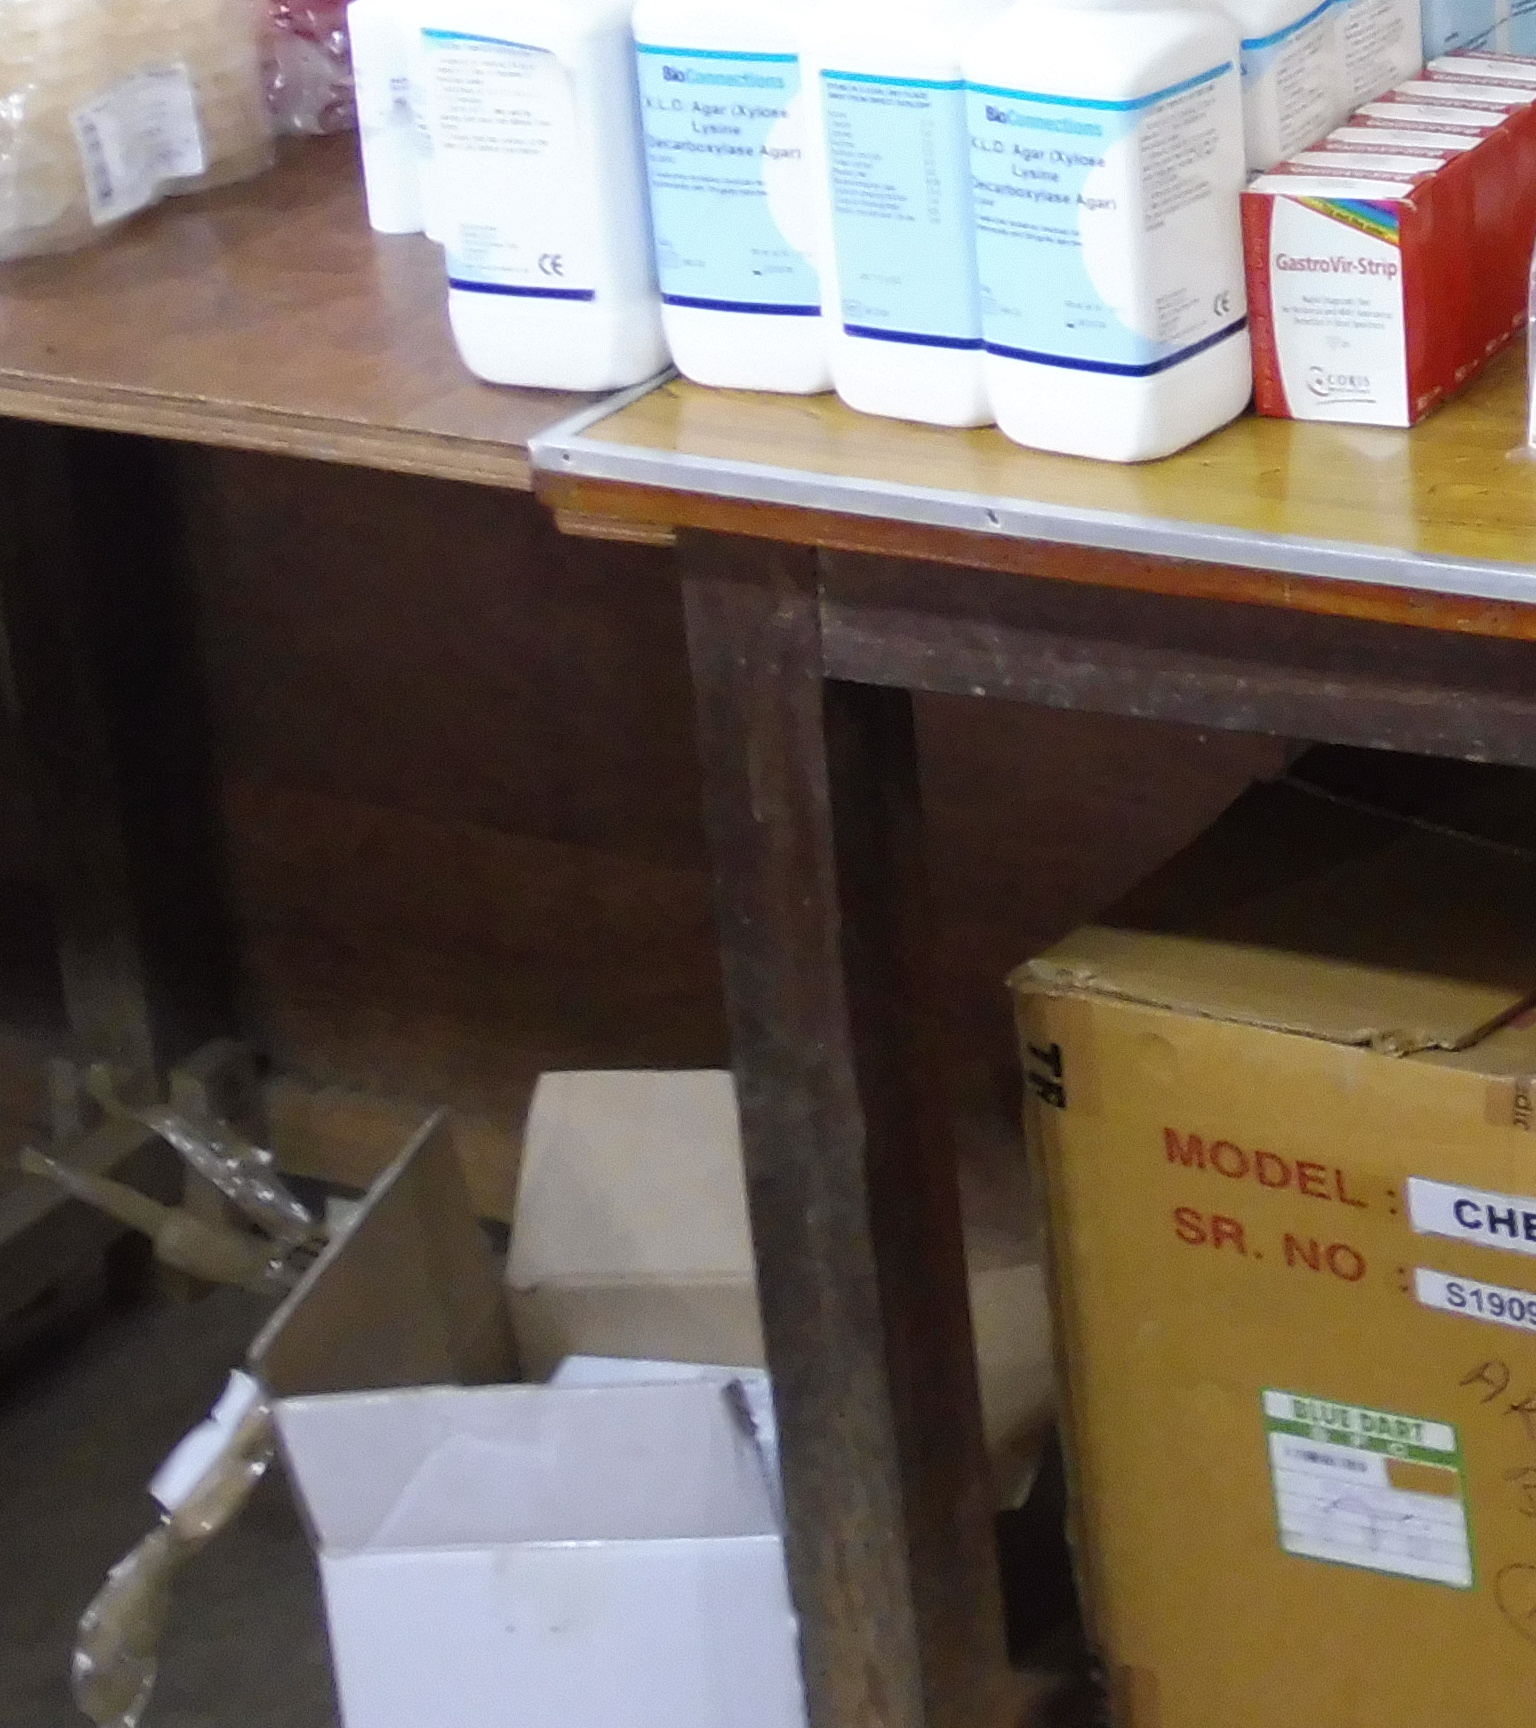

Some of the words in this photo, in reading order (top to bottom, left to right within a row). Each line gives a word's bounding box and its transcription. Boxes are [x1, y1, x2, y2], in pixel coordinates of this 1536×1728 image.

[692, 101, 726, 117] Agar
[691, 121, 741, 135] Lysine
[1013, 144, 1044, 162] Agar
[1012, 164, 1060, 182] Lysine
[1276, 253, 1398, 281] GastroVir-Strip
[1163, 1127, 1370, 1208] MODEL
[1172, 1206, 1264, 1260] SR.
[1283, 1232, 1368, 1282] NO
[1293, 1398, 1350, 1428] BLUE
[1359, 1412, 1423, 1442] DART
